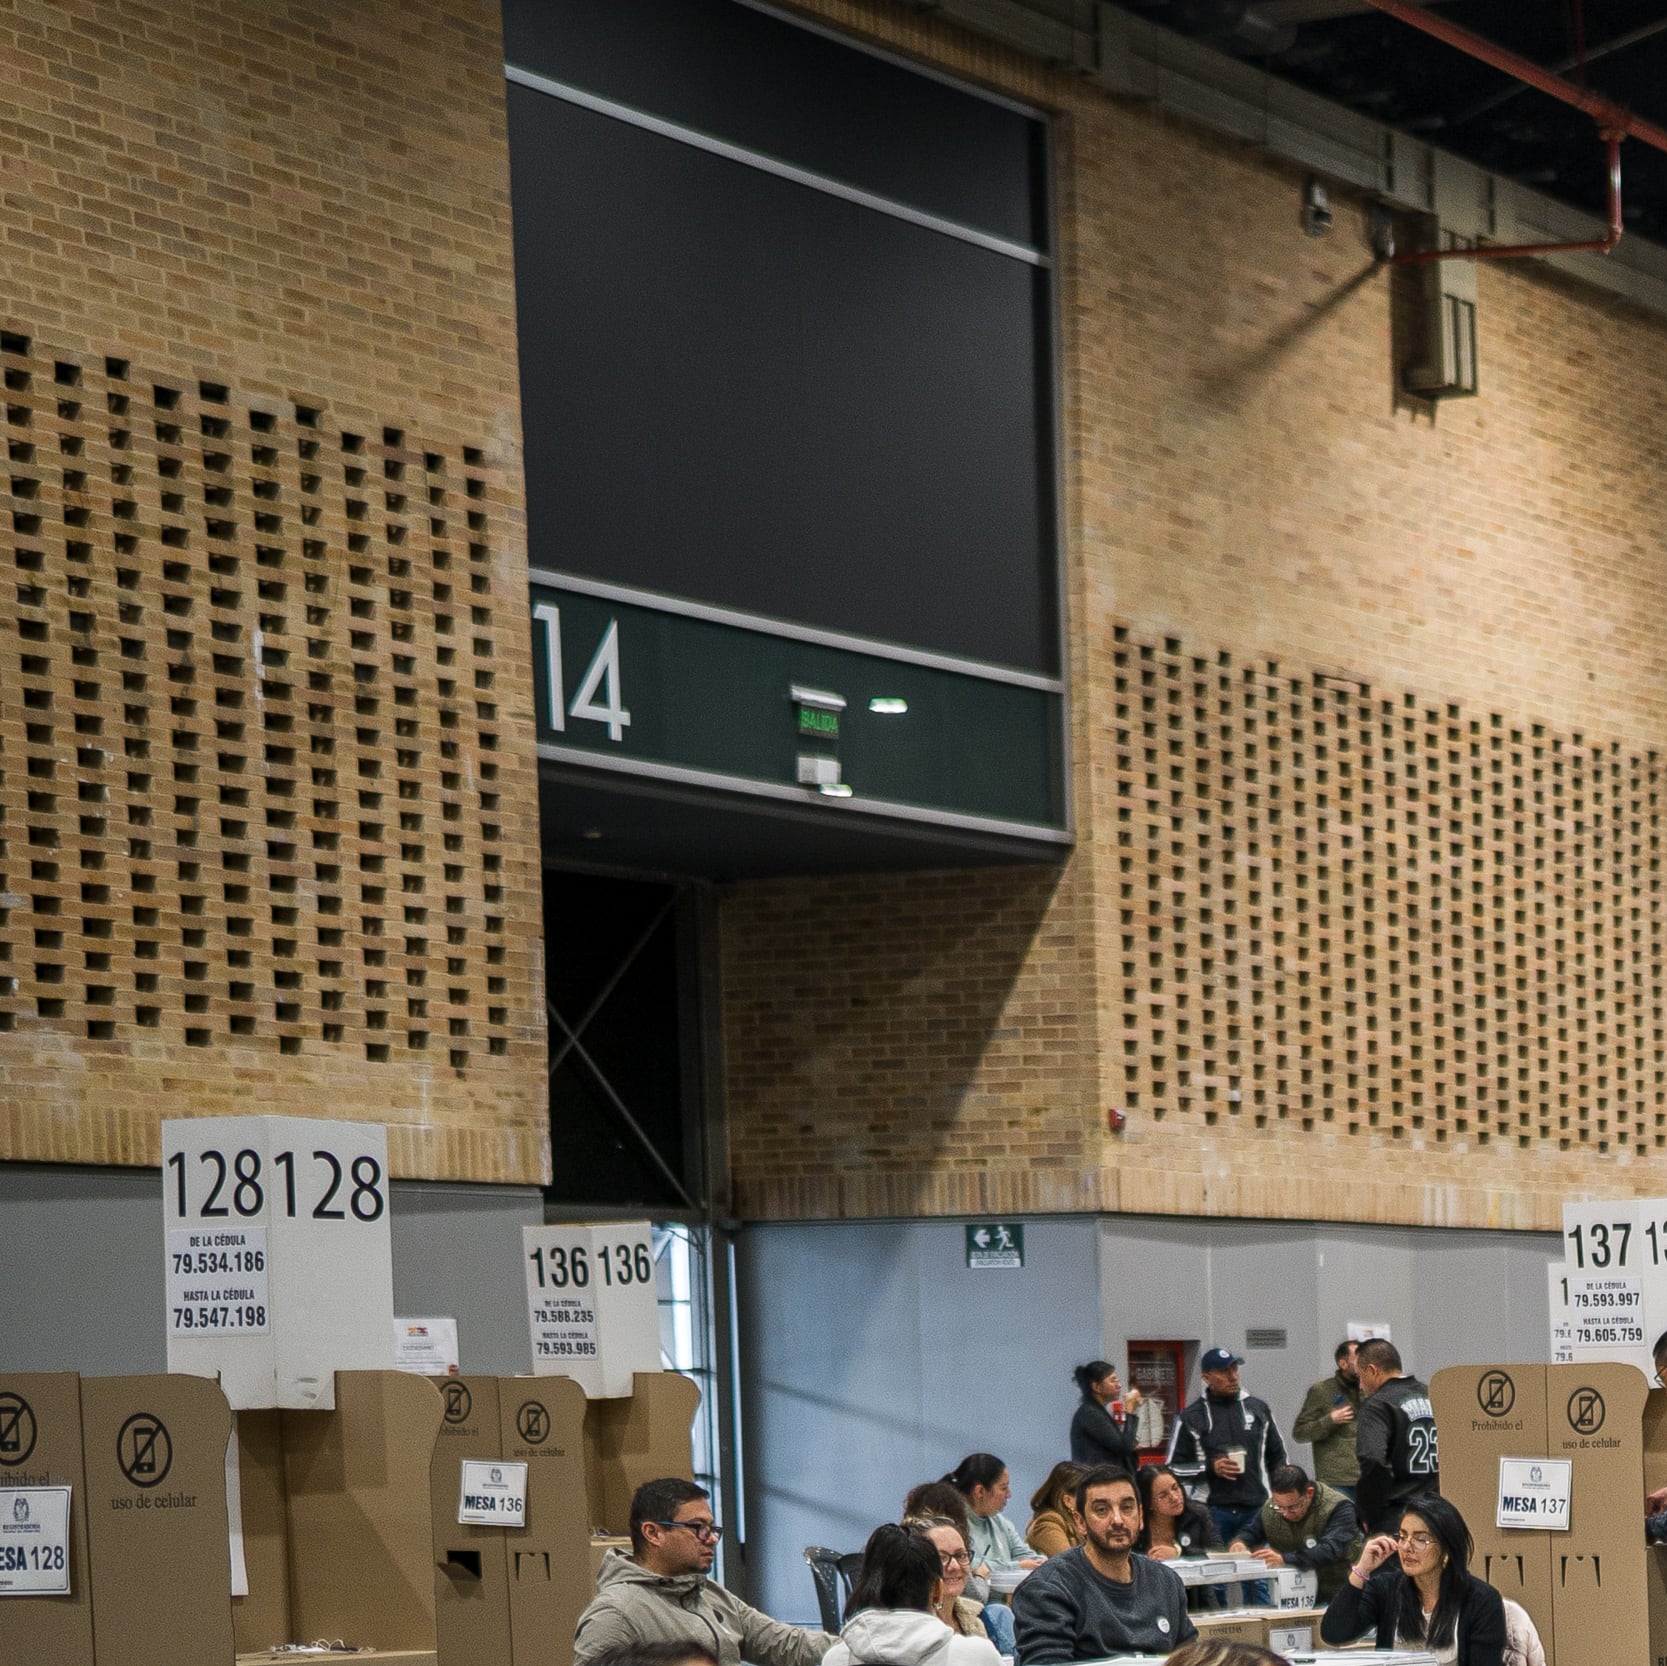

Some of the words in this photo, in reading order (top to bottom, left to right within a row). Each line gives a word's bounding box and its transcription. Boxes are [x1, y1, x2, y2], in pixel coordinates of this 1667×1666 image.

[533, 603, 630, 741] 14
[801, 710, 839, 733] SALIDA
[168, 1149, 264, 1217] 128
[274, 1151, 384, 1222] 128
[190, 1237, 200, 1247] DE
[203, 1236, 212, 1246] LA
[215, 1234, 246, 1246] CÉDULA
[1568, 1223, 1631, 1269] 137
[173, 1251, 264, 1274] 79.534.186
[530, 1246, 589, 1288] 136
[598, 1244, 651, 1286] 136
[184, 1291, 208, 1301] HASTA
[211, 1291, 220, 1301] LA
[223, 1288, 254, 1300] CÉDULA
[1575, 1293, 1640, 1308] 79.593.997
[174, 1306, 266, 1329] 79.547.198
[1577, 1328, 1642, 1342] 79.605.759
[1472, 1420, 1514, 1431] Prohibido
[1517, 1420, 1523, 1430] el
[1563, 1440, 1578, 1449] uso
[1580, 1439, 1591, 1448] de
[1592, 1438, 1621, 1448] celular
[111, 1498, 132, 1510] uso
[137, 1494, 150, 1508] de
[155, 1493, 197, 1508] celular
[465, 1496, 495, 1511] MESA
[499, 1497, 522, 1512] 136
[1502, 1496, 1537, 1512] MESA
[1541, 1499, 1565, 1514] 137
[0, 1547, 27, 1570] ESA
[31, 1546, 64, 1570] 128
[1281, 1598, 1299, 1609] MESA
[1301, 1596, 1314, 1607] 136
